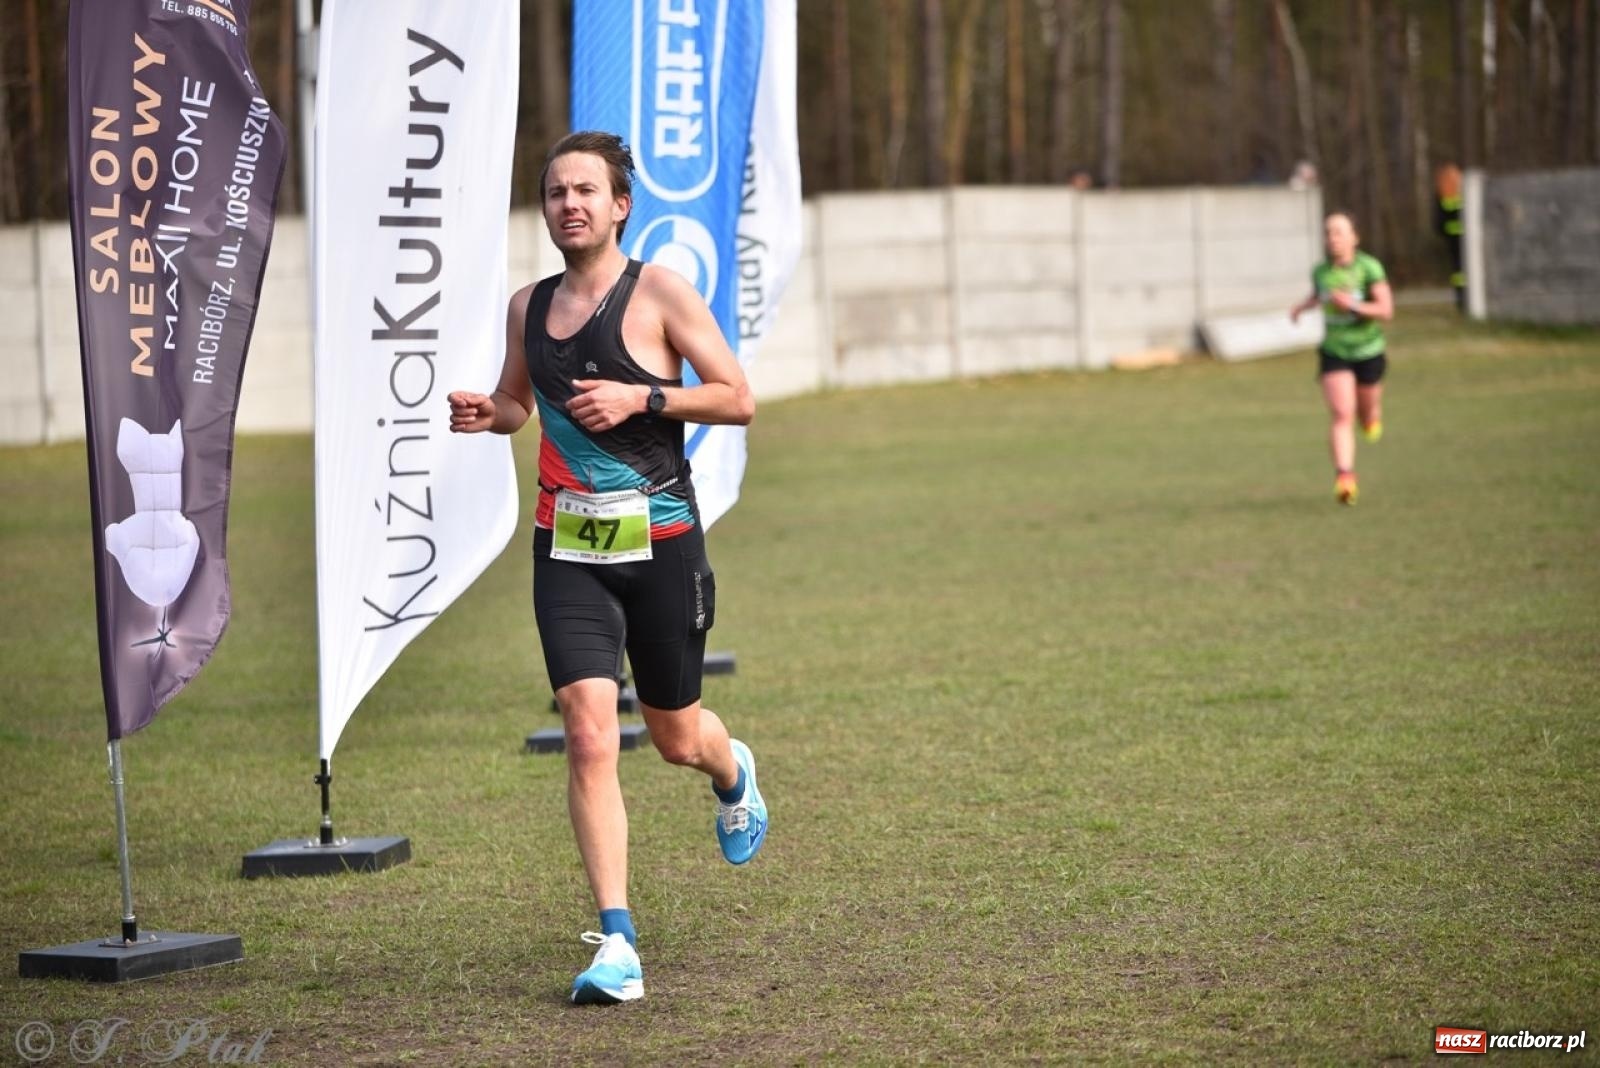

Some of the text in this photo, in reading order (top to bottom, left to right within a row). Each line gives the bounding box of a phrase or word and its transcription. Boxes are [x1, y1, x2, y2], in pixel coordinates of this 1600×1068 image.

[160, 0, 185, 14] TEL.
[187, 5, 208, 19] 885
[89, 106, 121, 294] SALON
[163, 76, 217, 215] HOME
[192, 276, 236, 385] RACIBÓRZ,
[215, 236, 244, 269] UL.
[736, 231, 769, 341] Rudy
[577, 518, 621, 550] 47
